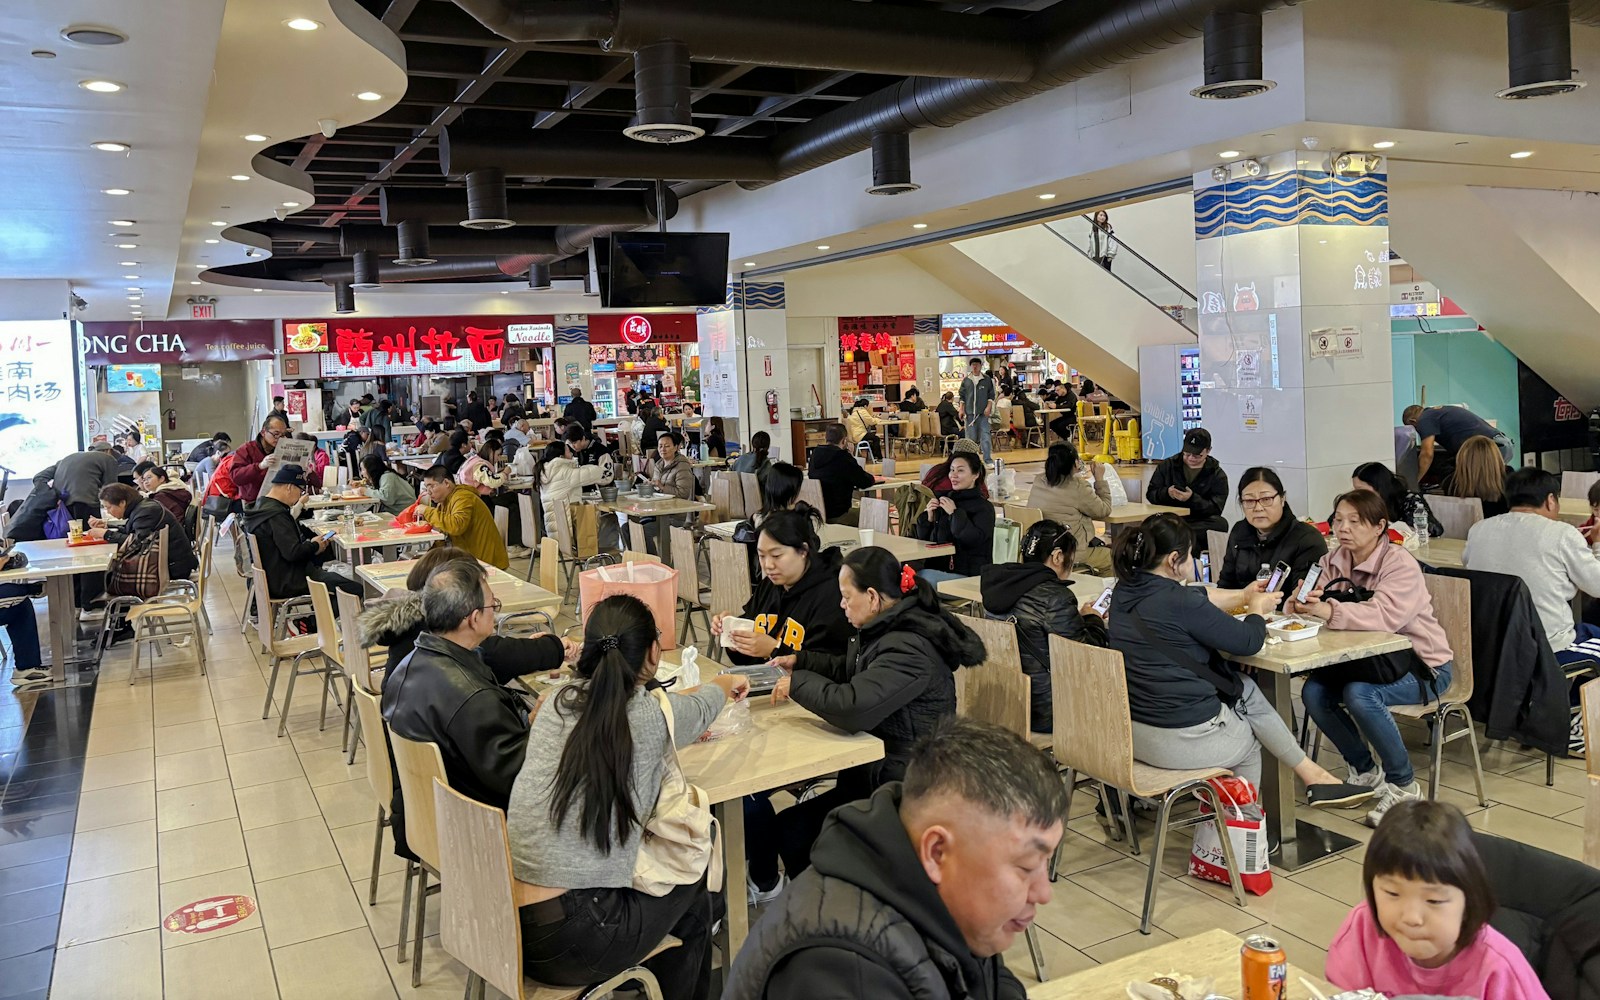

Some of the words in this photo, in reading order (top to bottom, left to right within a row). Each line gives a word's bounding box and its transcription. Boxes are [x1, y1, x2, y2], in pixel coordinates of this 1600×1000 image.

[193, 305, 212, 318] EXIT
[0, 335, 52, 352] 川一
[135, 333, 187, 352] CHA
[512, 332, 551, 343] Noodle
[949, 328, 982, 350] 八福
[0, 382, 62, 403] 肉汤
